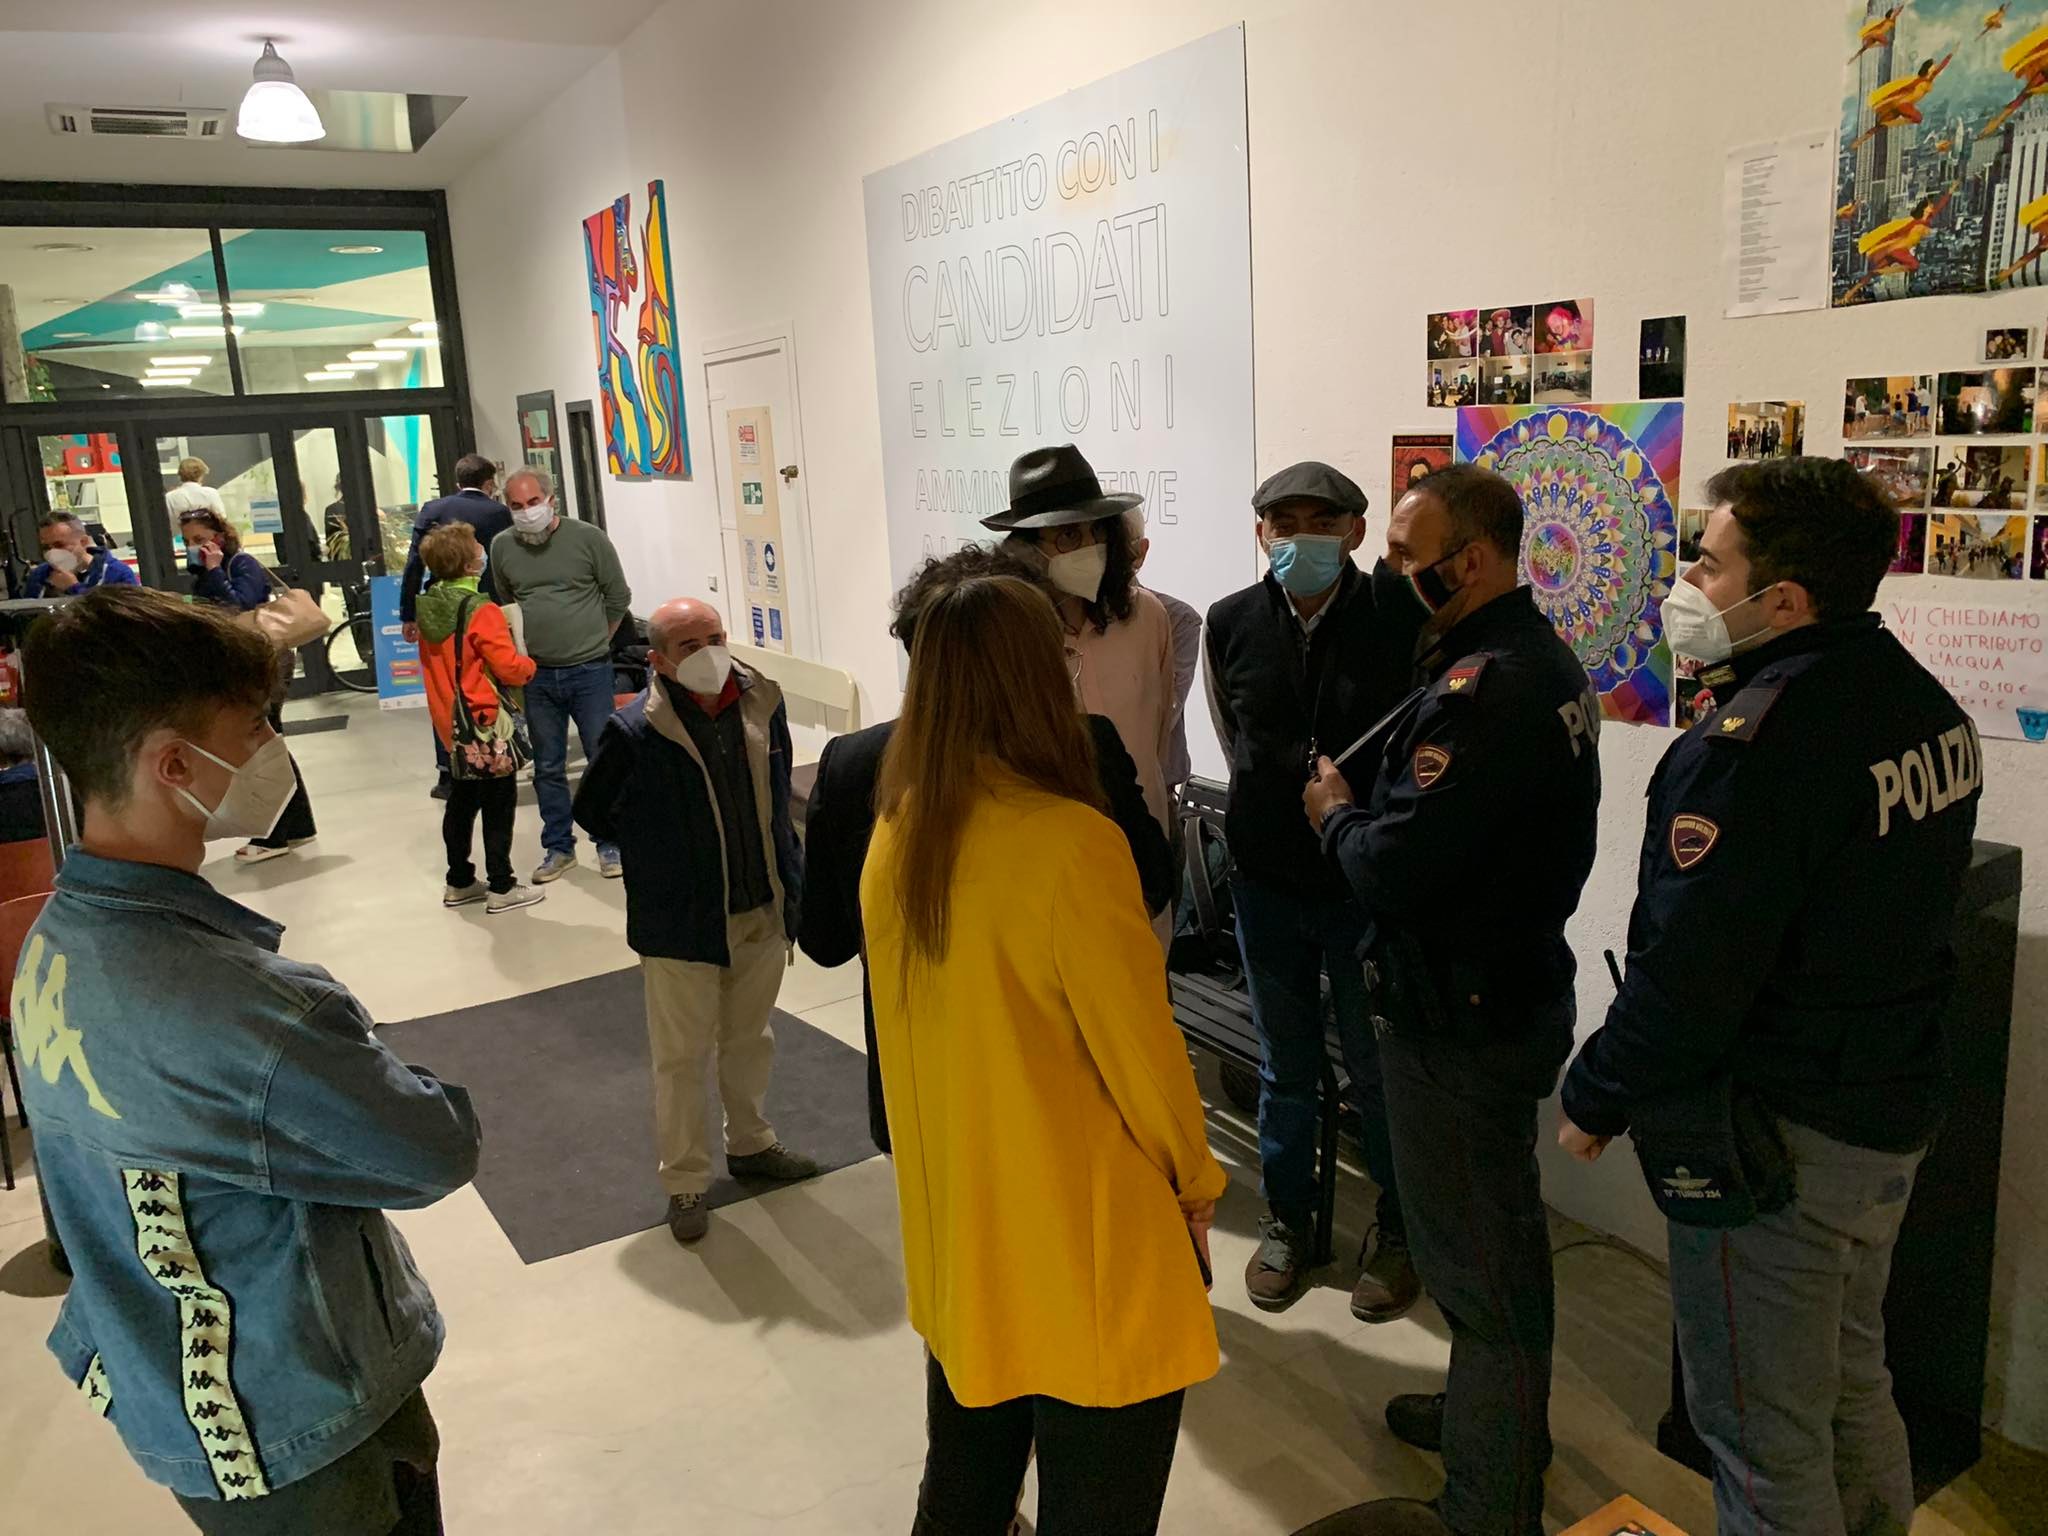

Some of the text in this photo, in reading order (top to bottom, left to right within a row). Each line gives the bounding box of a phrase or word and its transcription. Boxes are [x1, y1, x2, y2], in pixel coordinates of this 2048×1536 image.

[901, 108, 1160, 242] DIBATTITO CON I
[903, 203, 1169, 353] CANDIDATI
[909, 354, 1175, 439] ELEZIONI
[1891, 602, 2041, 629] VI CHIEDIAMO
[1925, 633, 2043, 654] CONTRIBUTO
[1929, 651, 2005, 671] L'ACQUA
